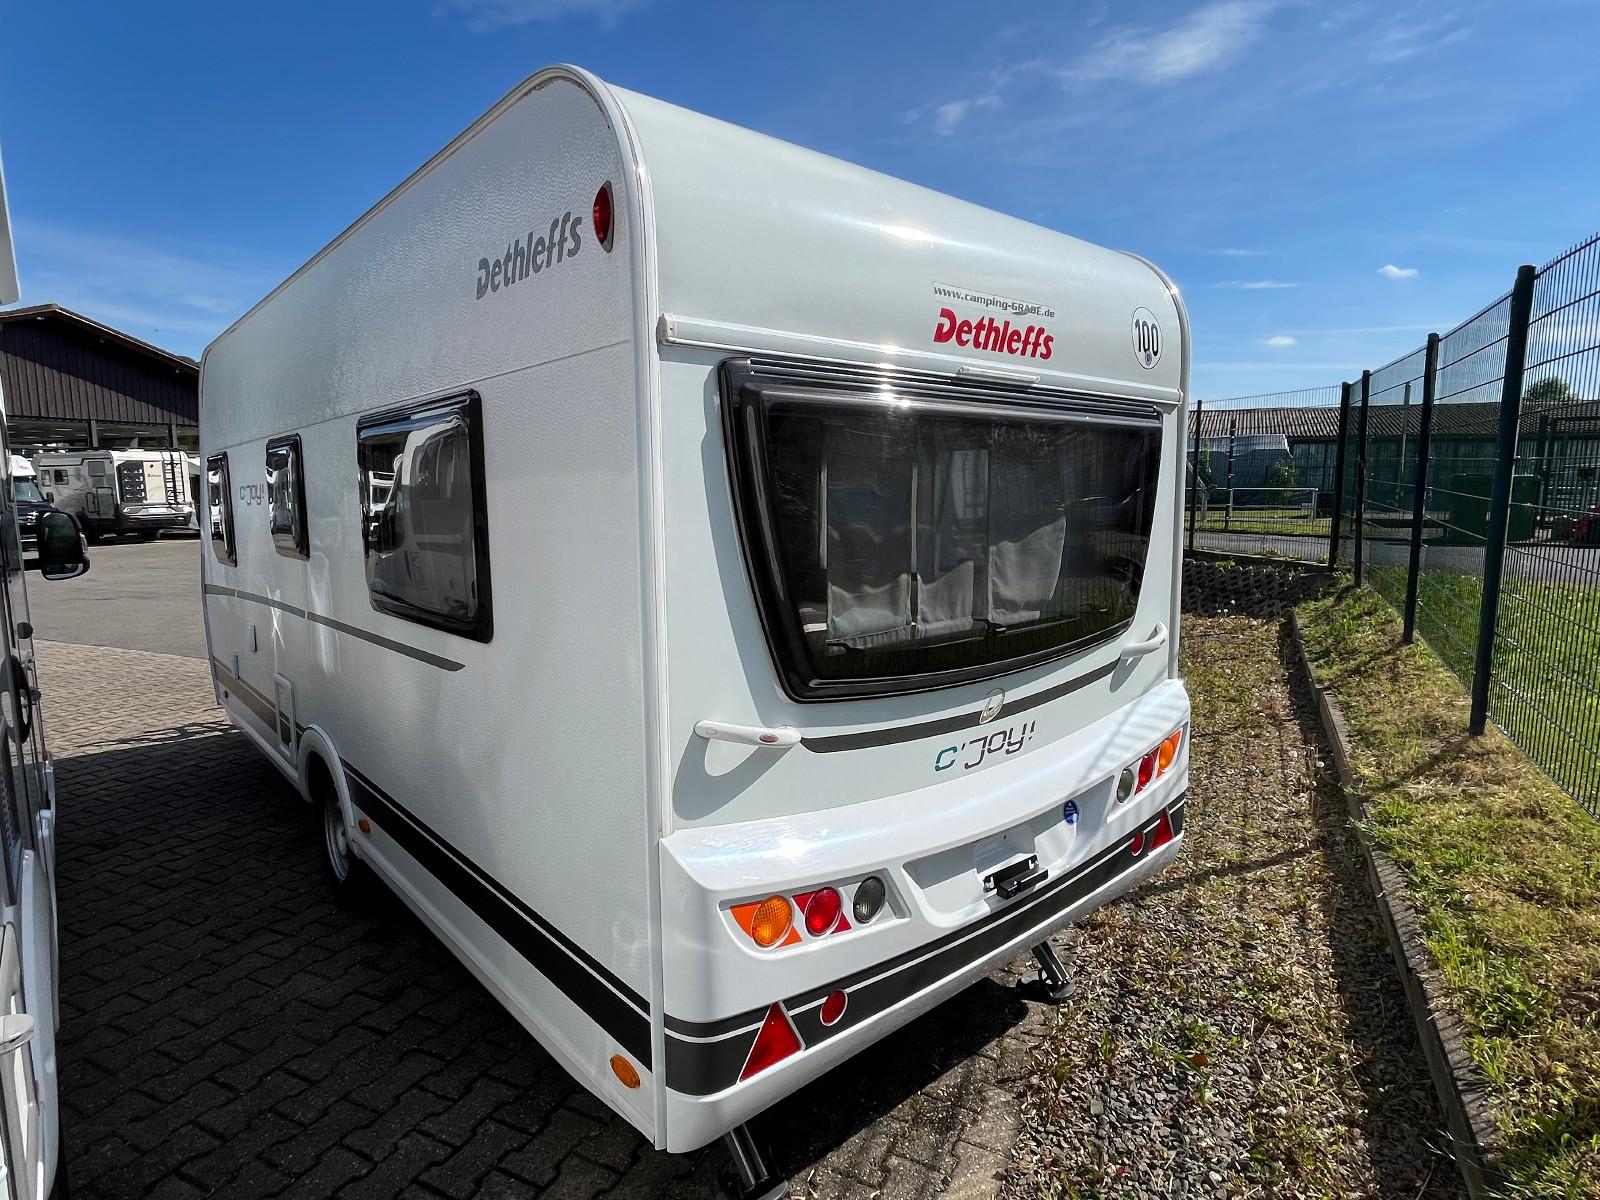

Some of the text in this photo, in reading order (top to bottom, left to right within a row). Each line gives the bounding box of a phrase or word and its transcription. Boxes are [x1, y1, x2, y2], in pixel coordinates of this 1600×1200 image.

[476, 211, 582, 300] Dethleffs
[934, 286, 1055, 318] www.camping-GRABE.de
[933, 307, 1055, 360] Dethleffs
[1135, 318, 1159, 356] 100
